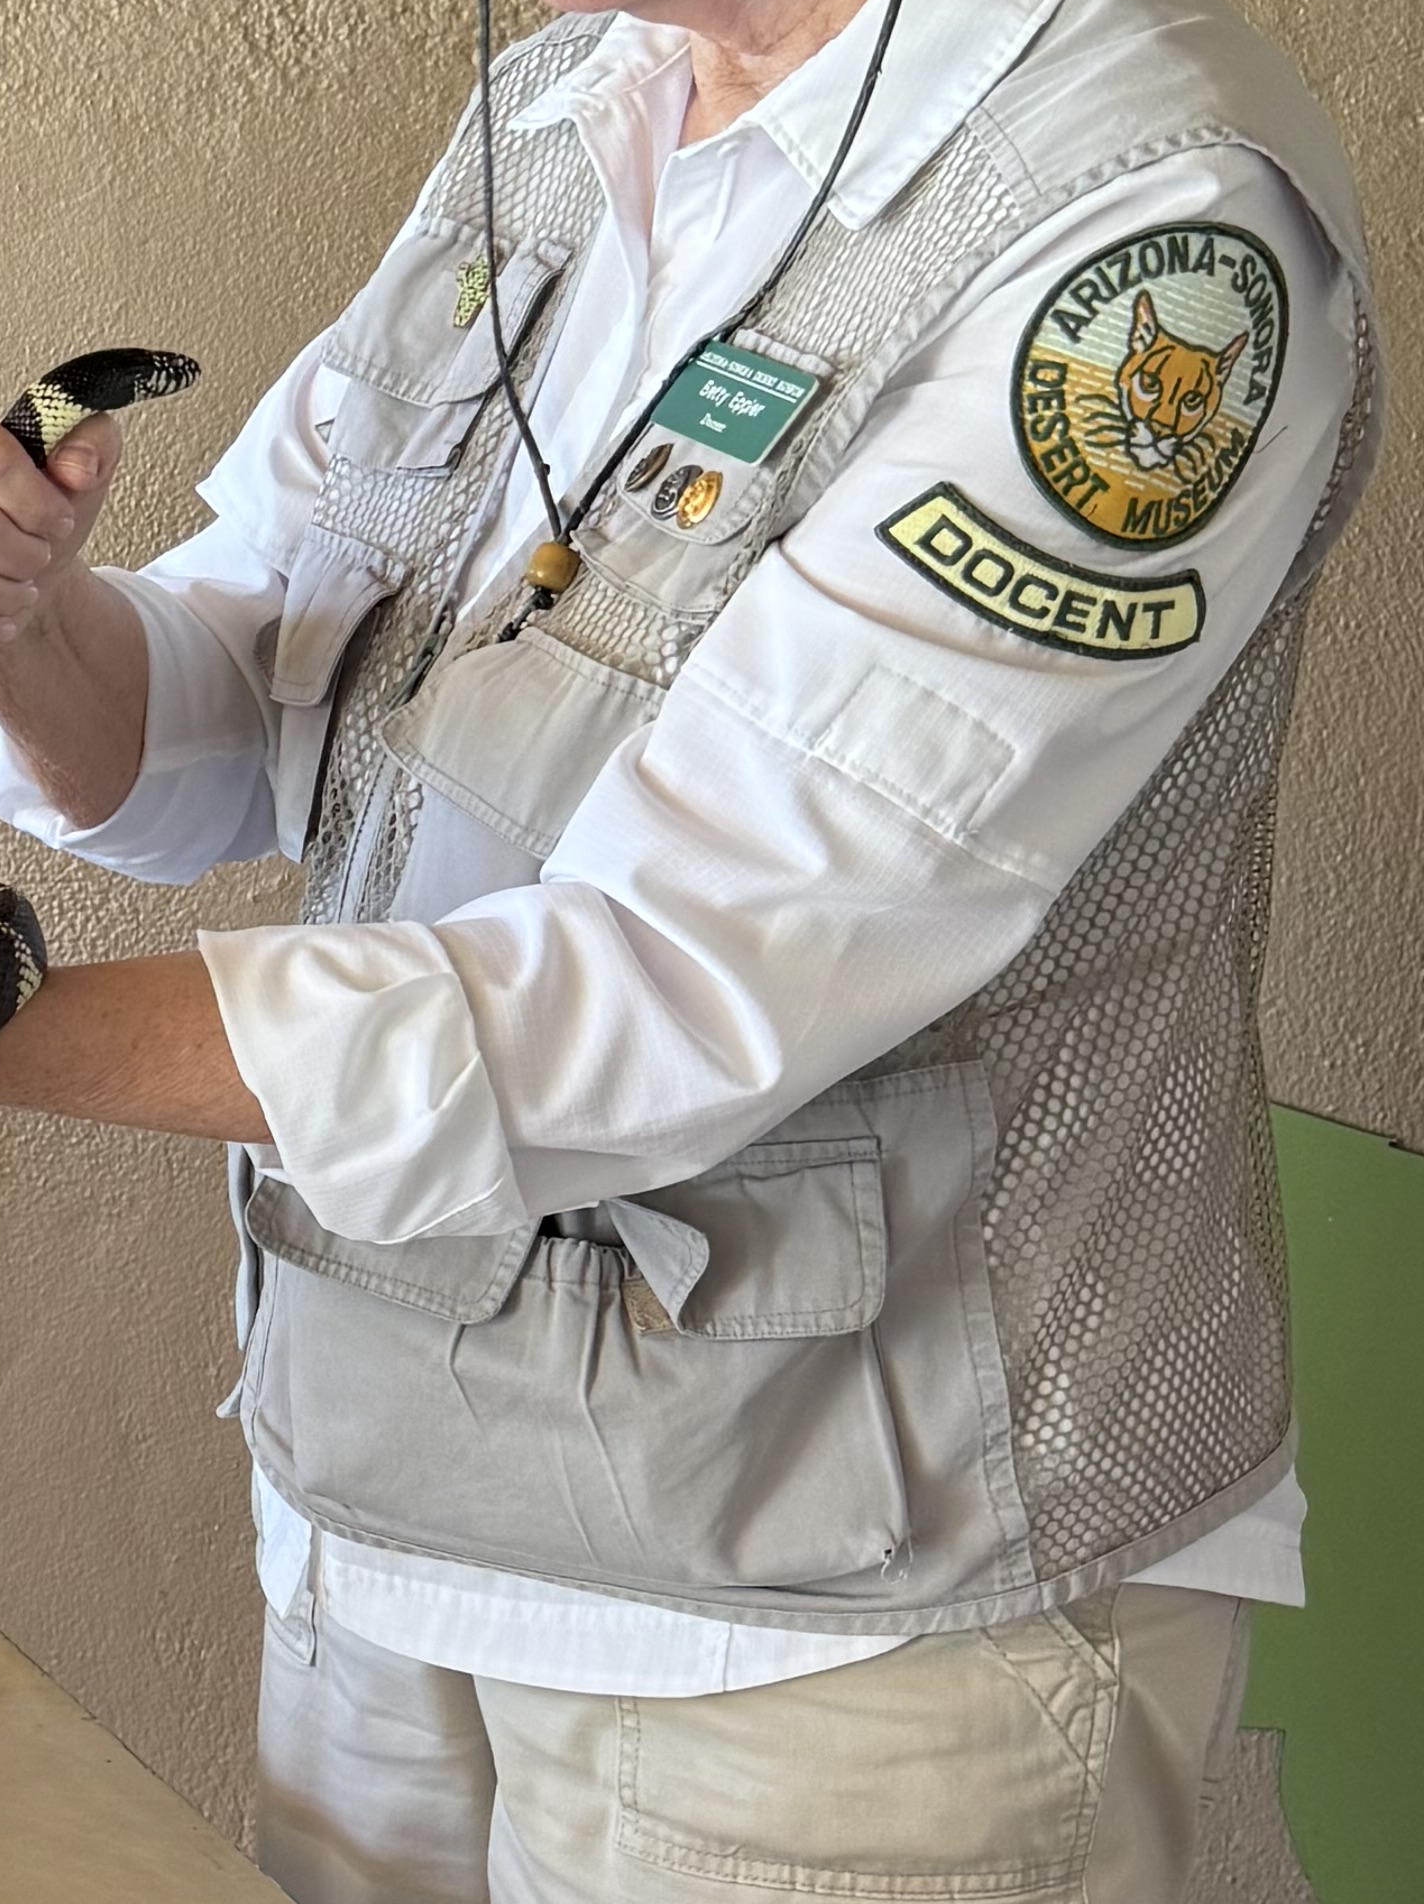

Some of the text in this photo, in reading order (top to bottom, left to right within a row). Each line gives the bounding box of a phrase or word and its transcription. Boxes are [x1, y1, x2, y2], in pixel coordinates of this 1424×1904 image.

[1052, 235, 1275, 405] ARIZONA-SONORA
[1028, 359, 1245, 536] DESERT MUSEUM
[914, 514, 1175, 641] DOCENT
